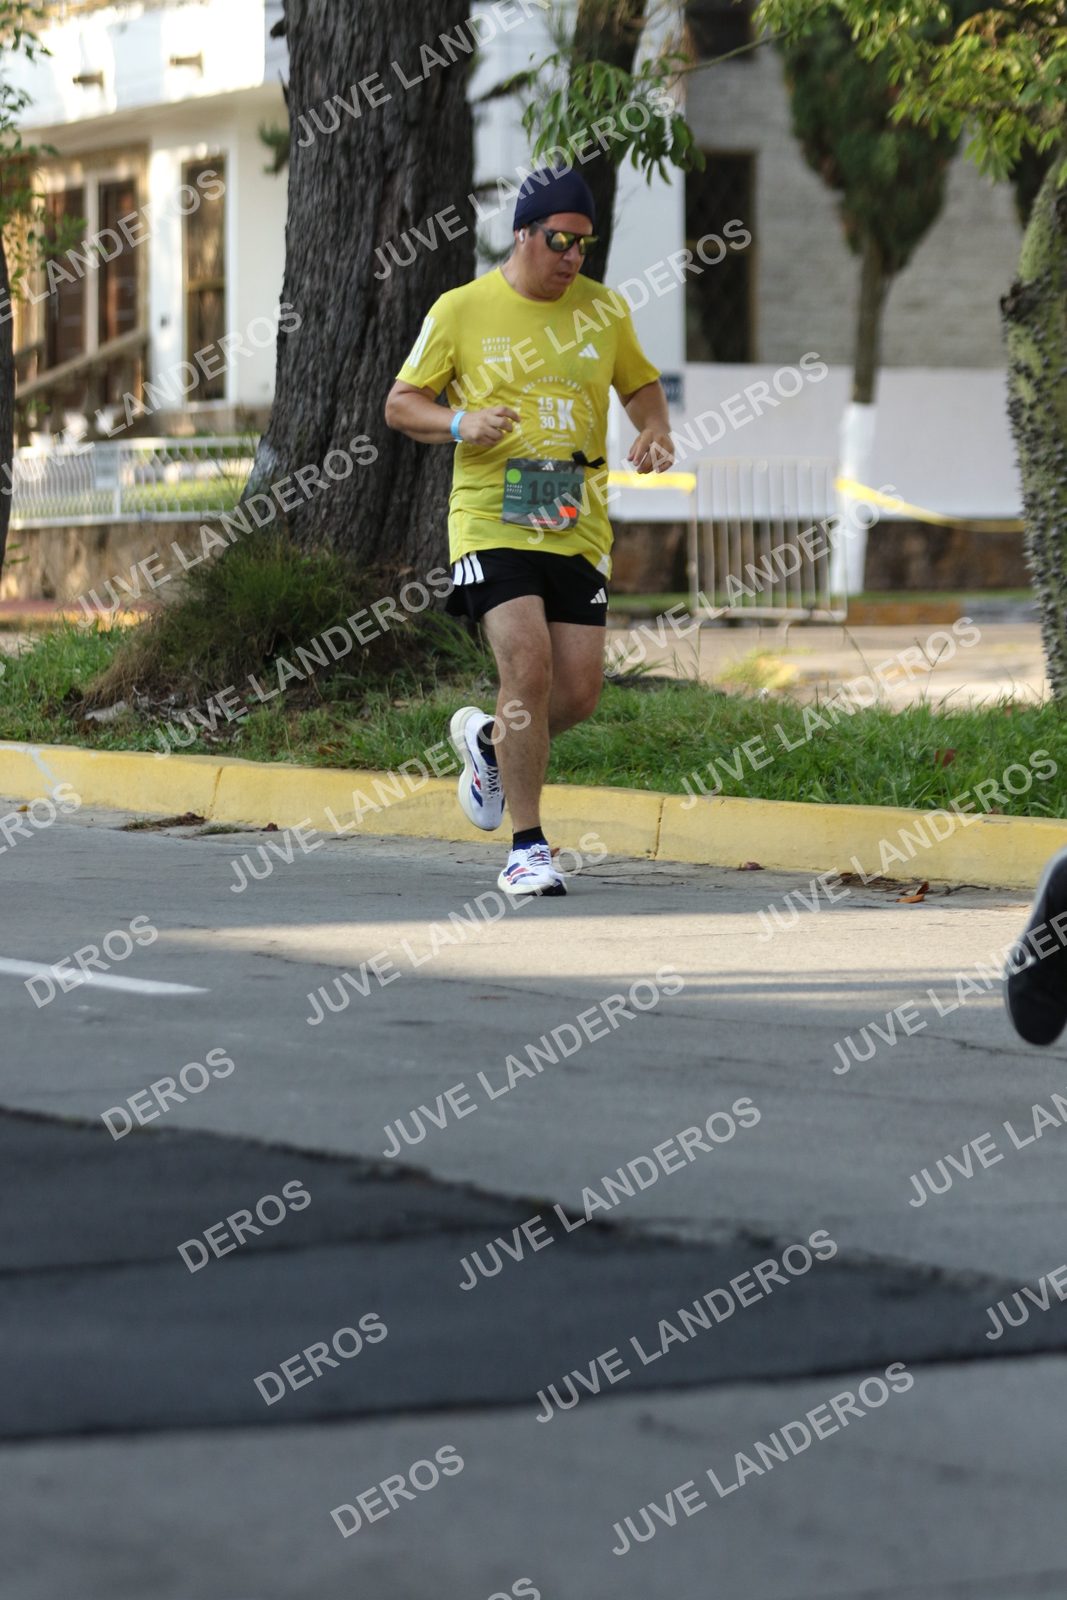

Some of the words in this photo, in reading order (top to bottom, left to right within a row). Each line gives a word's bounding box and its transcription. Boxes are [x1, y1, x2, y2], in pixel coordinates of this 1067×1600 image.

[537, 396, 554, 411] 15
[540, 415, 556, 429] 30
[557, 398, 576, 432] K
